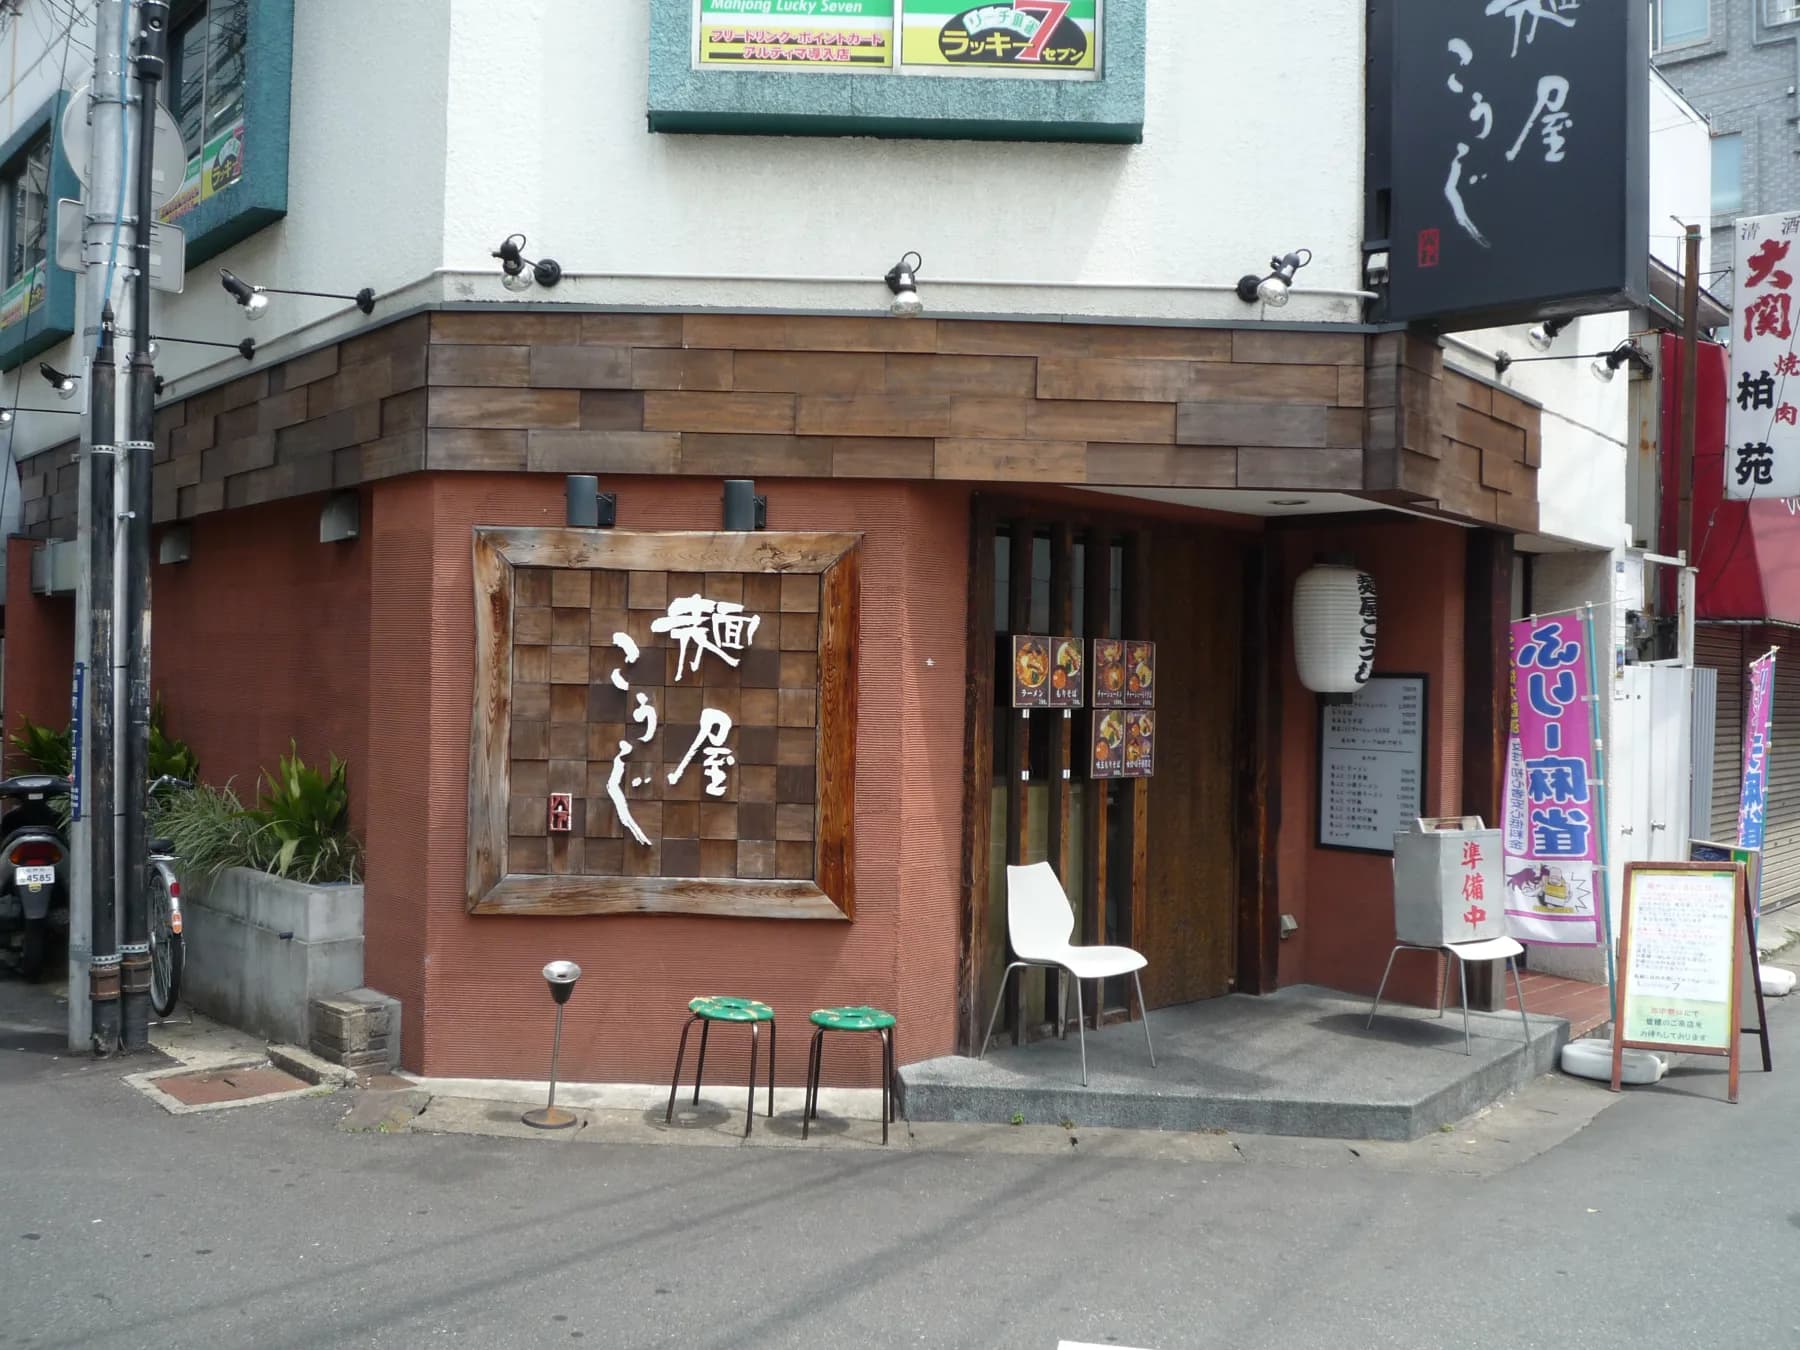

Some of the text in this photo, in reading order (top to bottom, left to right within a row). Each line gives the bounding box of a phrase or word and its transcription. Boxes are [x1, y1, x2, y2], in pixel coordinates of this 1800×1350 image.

[710, 0, 862, 15] Mahjong Lucky Seven
[711, 29, 882, 47] フリードリンク・ポイントカード
[743, 46, 851, 61] アルティマ導入店
[1042, 47, 1084, 62] セブン
[1445, 38, 1492, 249] こうじ
[1743, 238, 1793, 343] 大関
[1735, 369, 1776, 486] 柏苑
[1773, 350, 1800, 427] 焼肉
[607, 632, 658, 845] こうじ
[651, 594, 760, 796] 麺屋
[1461, 839, 1487, 931] 準備中
